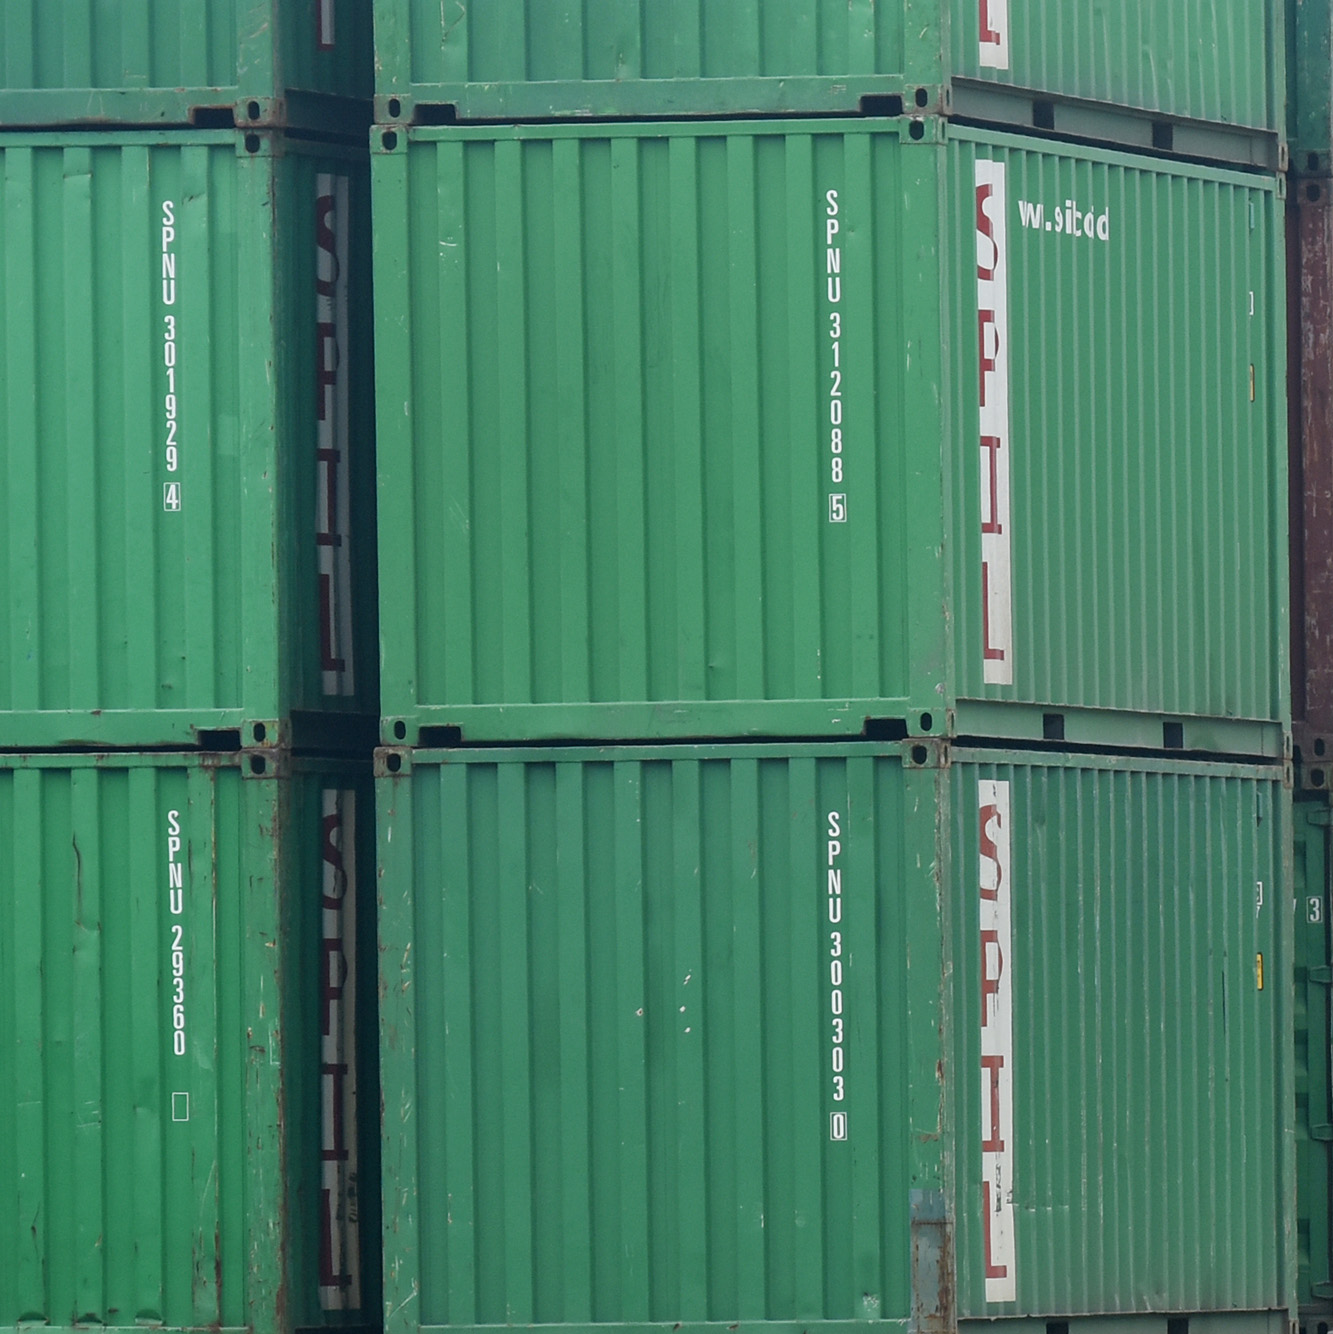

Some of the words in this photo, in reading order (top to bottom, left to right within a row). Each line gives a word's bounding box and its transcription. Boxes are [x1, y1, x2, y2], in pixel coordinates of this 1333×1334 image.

[162, 201, 175, 305] SPNU
[826, 190, 840, 303] SPNU
[164, 316, 178, 472] 301929
[830, 313, 843, 484] 312088
[165, 484, 180, 510] 4
[831, 495, 845, 521] 5
[168, 811, 183, 914] SPNU
[828, 811, 841, 923] SPNU
[1309, 899, 1320, 922] 3
[171, 926, 186, 1056] 29360
[830, 933, 844, 1101] 300303
